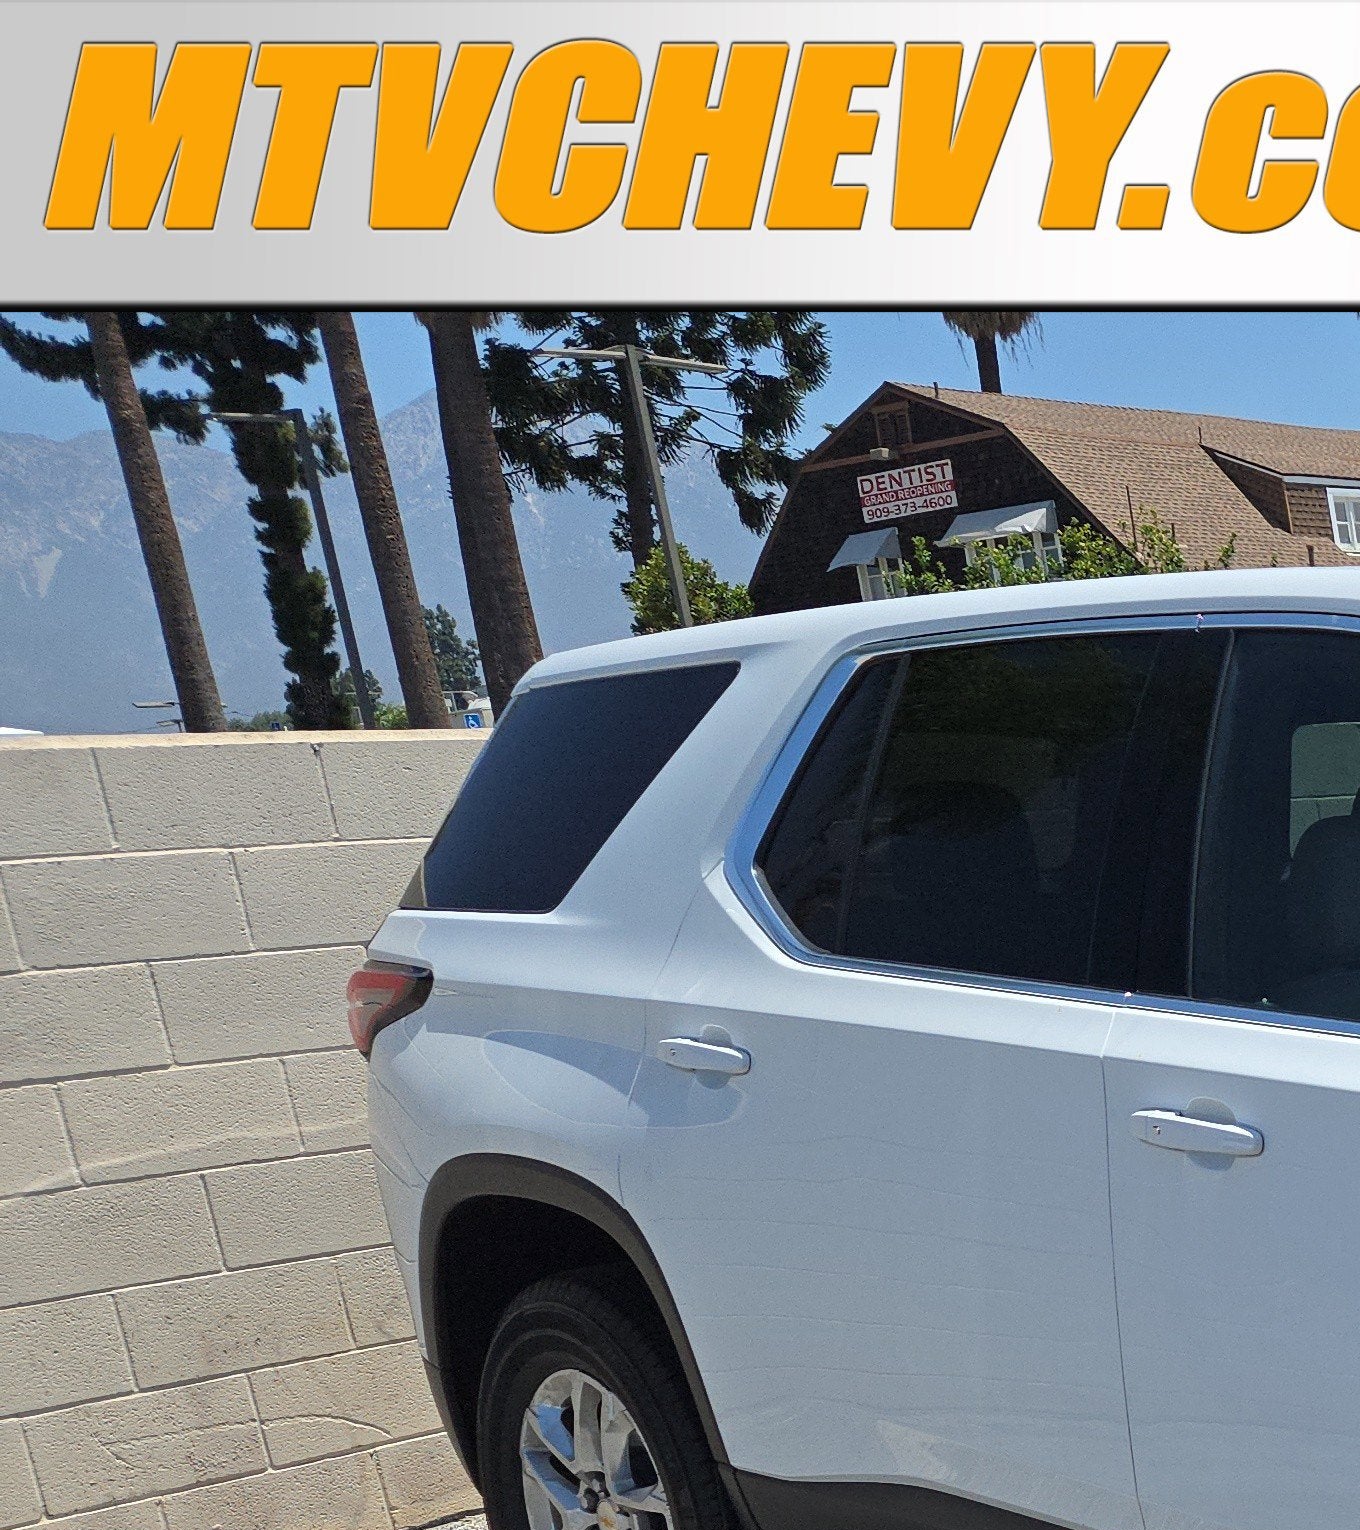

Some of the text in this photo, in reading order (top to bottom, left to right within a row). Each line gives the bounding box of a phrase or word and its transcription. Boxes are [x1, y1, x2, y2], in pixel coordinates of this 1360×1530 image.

[860, 462, 949, 495] DENTIST
[864, 481, 952, 507] GRAND REOPENING
[866, 494, 953, 521] 909-373-4600
